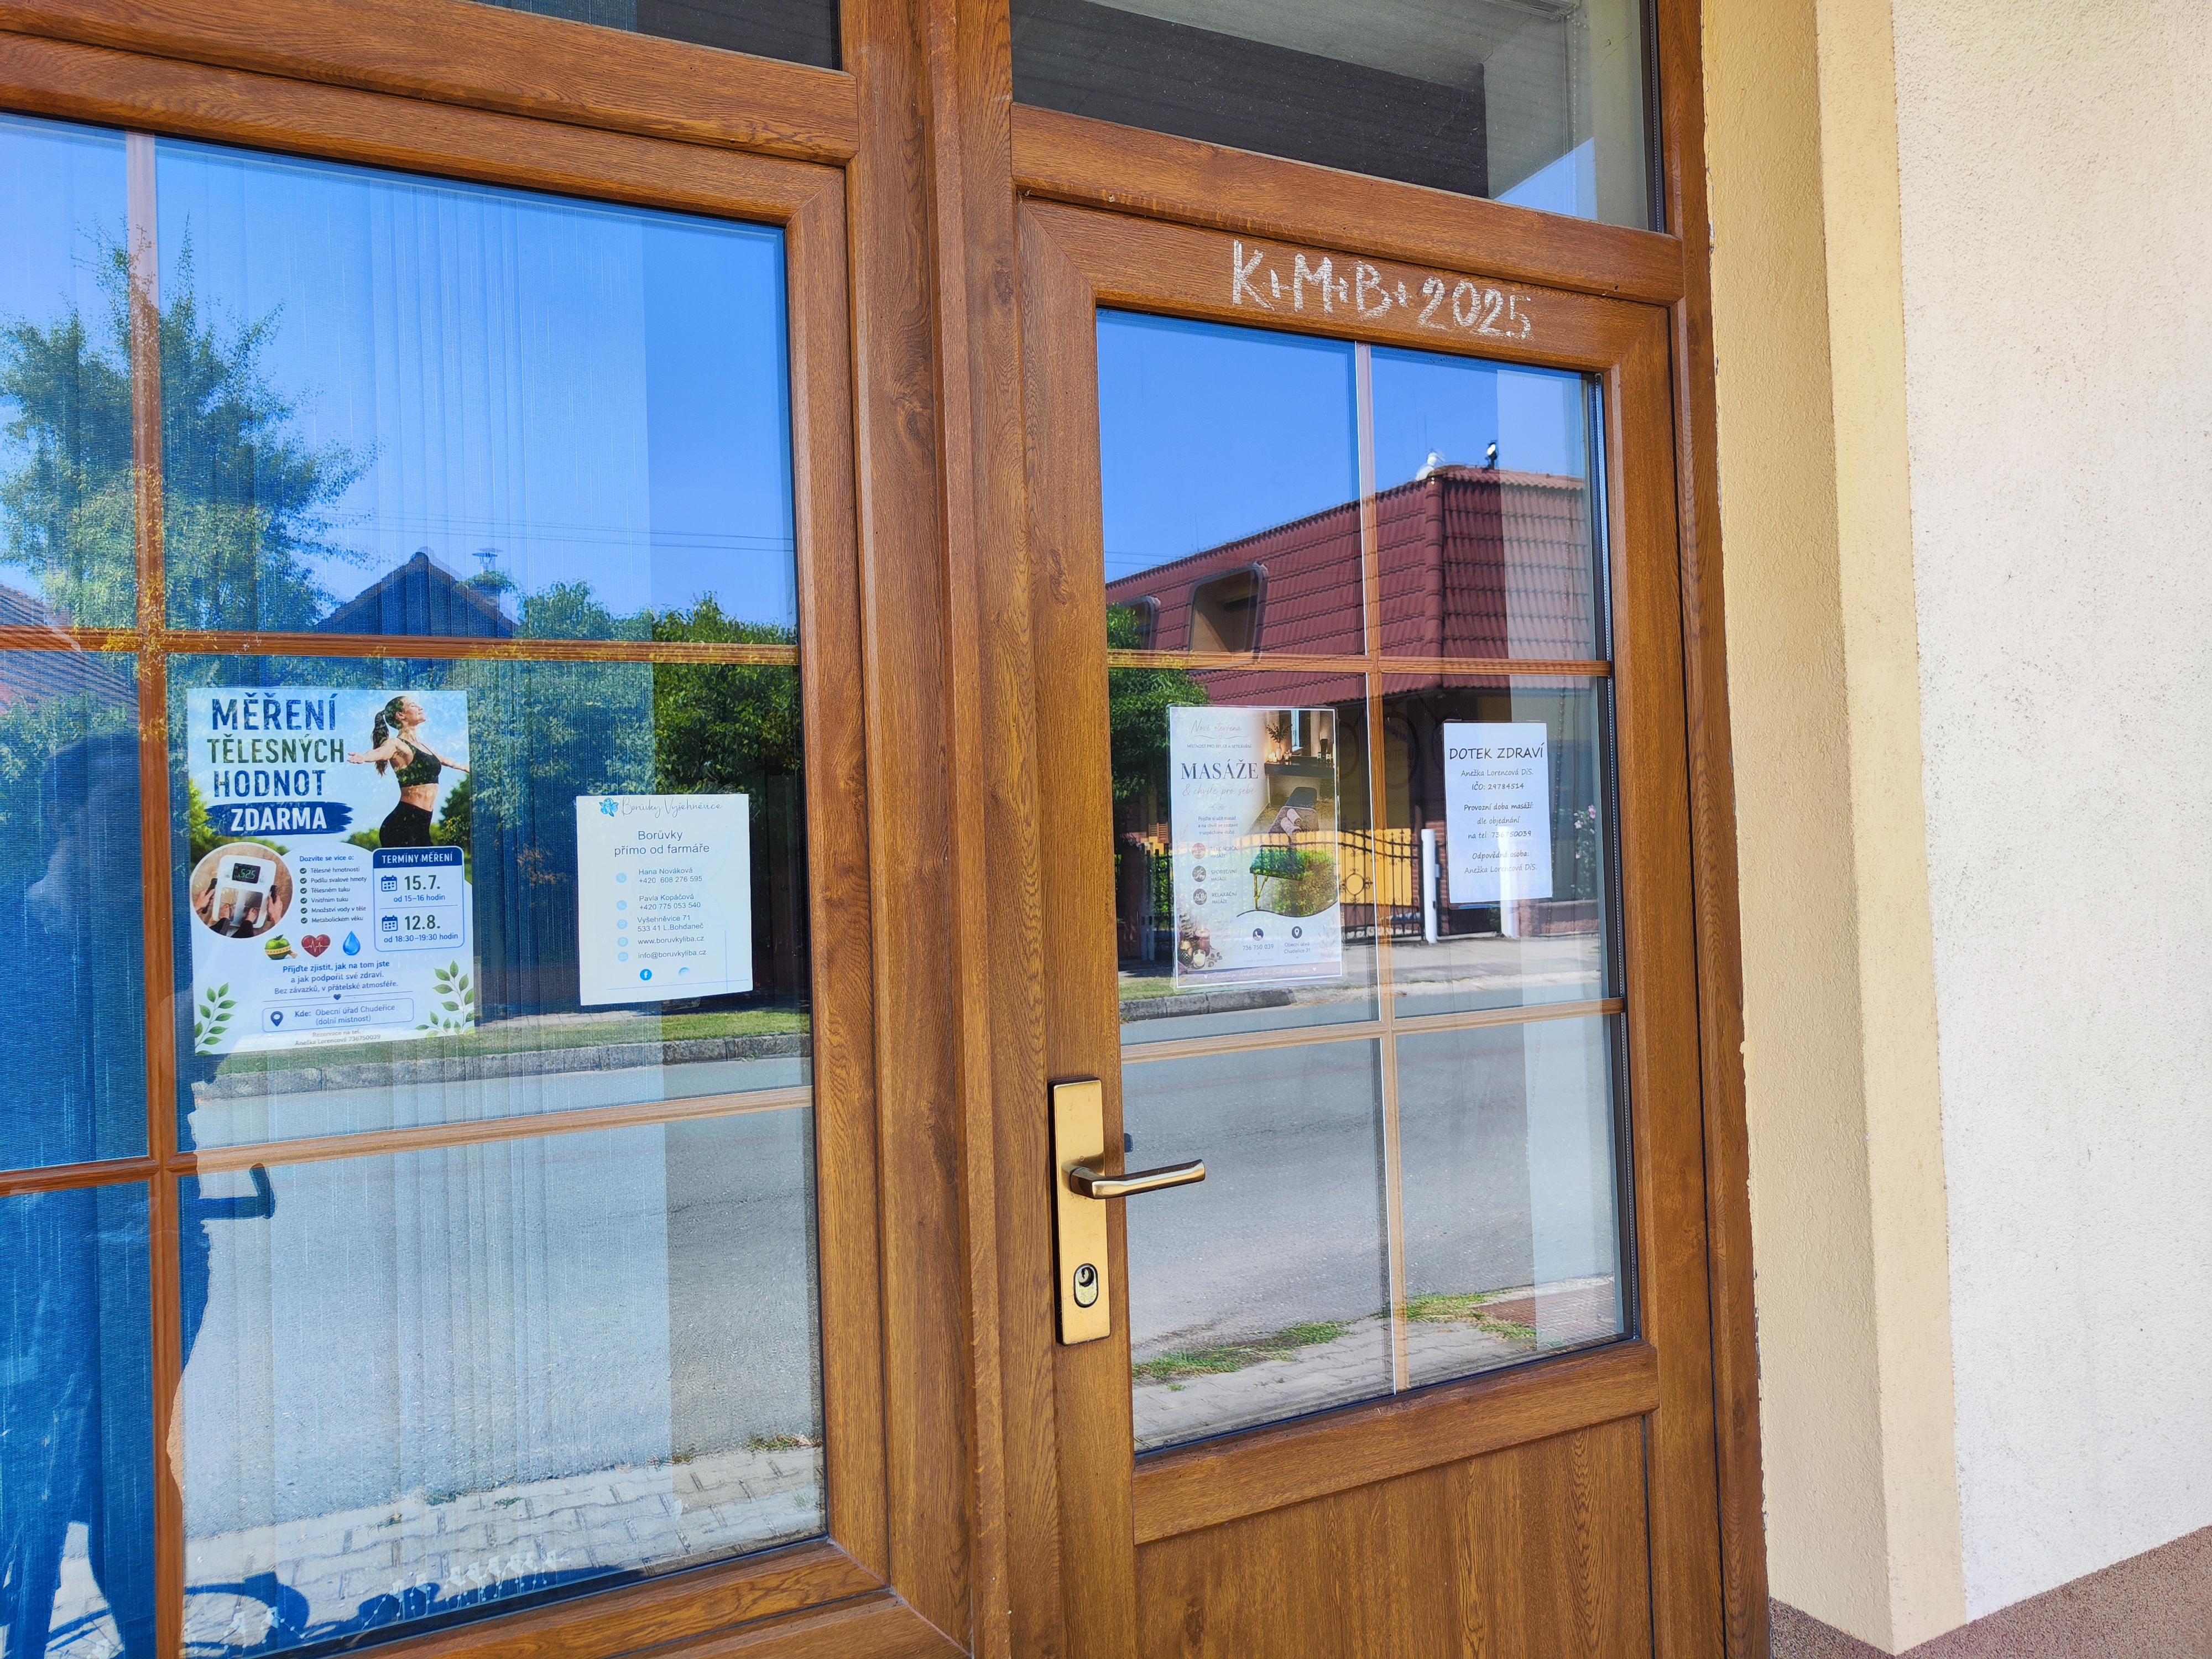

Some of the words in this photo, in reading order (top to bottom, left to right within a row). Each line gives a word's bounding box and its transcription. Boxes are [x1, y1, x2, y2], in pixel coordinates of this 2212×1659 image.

[212, 692, 338, 731] MĚŘENÍ
[207, 733, 345, 763] TĚLESNÝCH
[1449, 748, 1492, 760] DOTEK
[1497, 742, 1545, 759] ZDRAVÍ
[1181, 759, 1259, 780] MASÁŽE
[1460, 769, 1485, 777] Anežka
[1487, 768, 1519, 776] Lorencová
[214, 770, 326, 797] HODNOT
[1472, 781, 1485, 791] IČO:
[1182, 783, 1191, 796] &
[1220, 787, 1234, 800] pro
[1238, 783, 1256, 796] sebe
[664, 797, 722, 818] Vyšehněvice
[1464, 802, 1492, 811] Provozní
[1493, 802, 1509, 810] doba
[231, 807, 327, 831] ZDARMA
[1489, 816, 1521, 826] objednání
[638, 830, 683, 841] Borůvky
[1479, 831, 1489, 839] tel:
[614, 845, 646, 857] přímo
[650, 845, 664, 854] od
[667, 843, 709, 854] farmáře
[1472, 851, 1508, 862] Odpovědná
[1510, 849, 1530, 858] osoba:
[382, 853, 419, 864] TERMÍNY
[421, 852, 453, 862] MĚŘENÍ
[1464, 865, 1488, 874] Anežka
[1490, 864, 1522, 873] Lorencová
[404, 874, 441, 890] 15.7.
[404, 915, 441, 930] 12.8.
[637, 915, 680, 924] Vyšehněvice
[638, 936, 705, 945] www.boruvkyliba.cz
[638, 950, 706, 959] info@boruvkyliba.cz
[283, 965, 308, 974] Přijďte
[311, 964, 333, 973] zjistit,
[335, 962, 346, 971] jak
[376, 961, 390, 969] jste
[298, 975, 309, 984] jak
[311, 973, 343, 983] podpořit
[289, 985, 320, 994] závazků,
[327, 984, 360, 992] přátelské
[362, 980, 399, 989] atmosféře.
[343, 1006, 358, 1014] úřad
[360, 1004, 395, 1013] Chudeřice
[338, 1015, 371, 1024] místnost)
